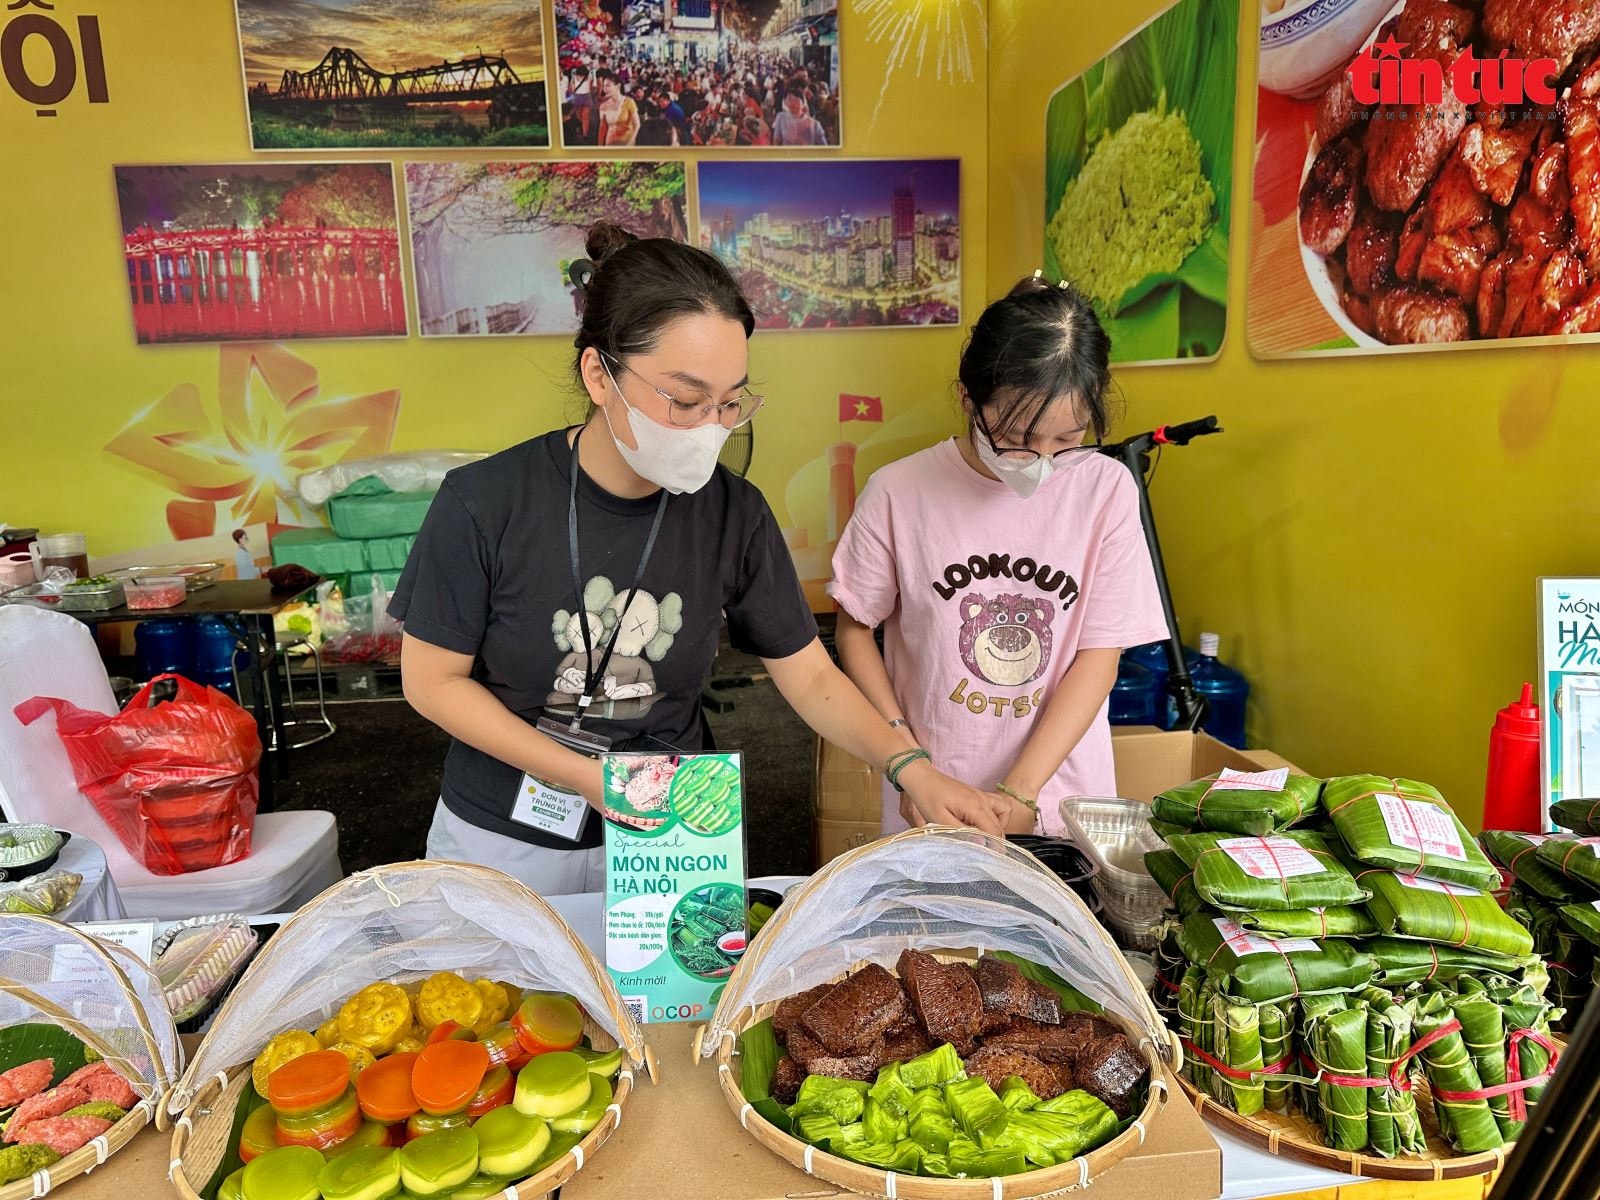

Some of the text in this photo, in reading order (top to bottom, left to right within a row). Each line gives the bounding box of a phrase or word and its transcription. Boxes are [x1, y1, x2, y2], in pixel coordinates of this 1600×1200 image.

[932, 553, 1079, 611] LOOKOUT!
[1559, 598, 1600, 613] MÓN
[1559, 614, 1600, 644] HÀ
[614, 830, 686, 853] Special
[613, 853, 728, 872] MÓN NGON
[613, 873, 678, 897] HÀ NỘI
[619, 975, 667, 986] Kính mời!
[651, 1003, 703, 1020] OCOP
